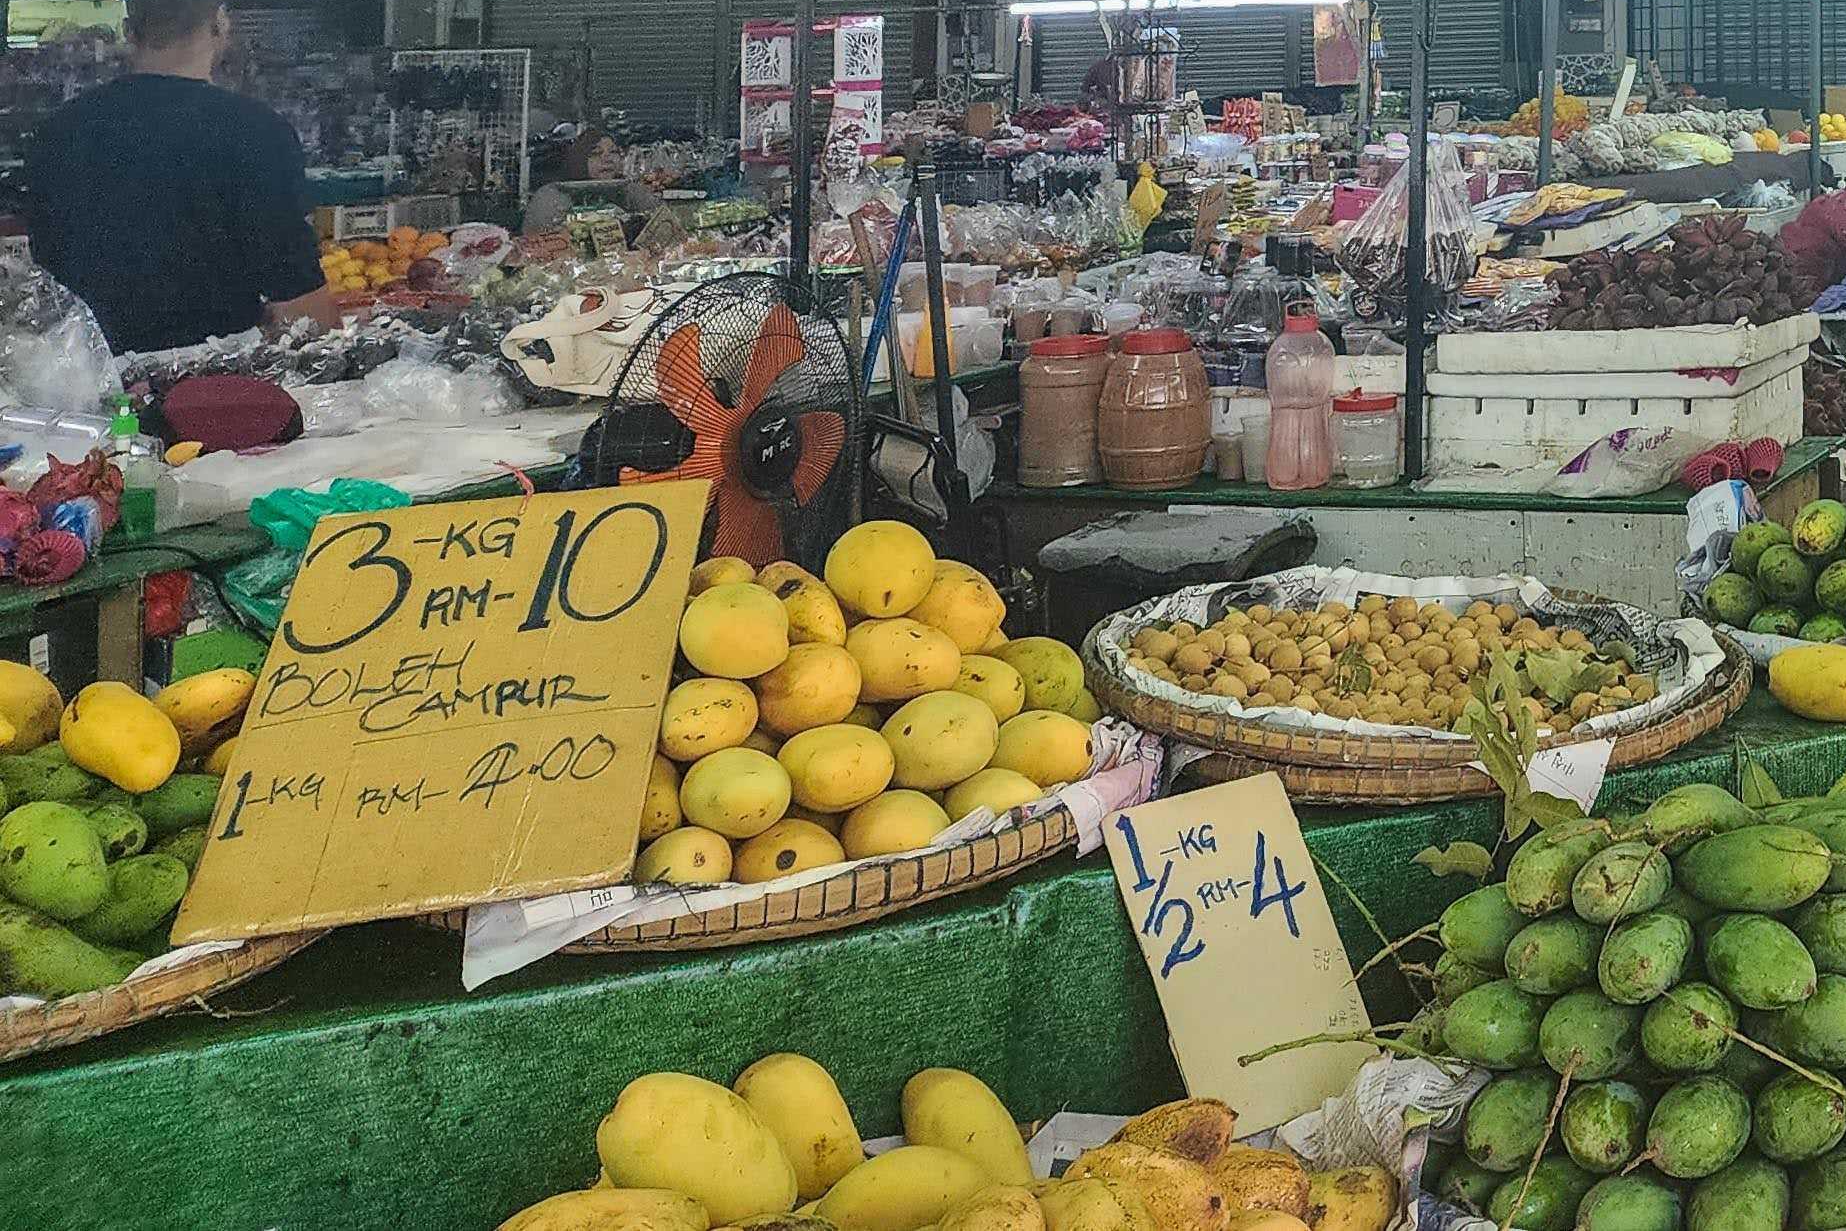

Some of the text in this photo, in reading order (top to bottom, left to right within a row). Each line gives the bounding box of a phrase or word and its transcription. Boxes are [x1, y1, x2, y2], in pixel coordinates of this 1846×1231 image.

[282, 520, 413, 654] 3
[517, 501, 669, 633] 10
[258, 640, 476, 719] BOLEH
[358, 673, 609, 733] CAMPUR
[459, 733, 618, 810] 4.00
[1249, 830, 1307, 939] 4
